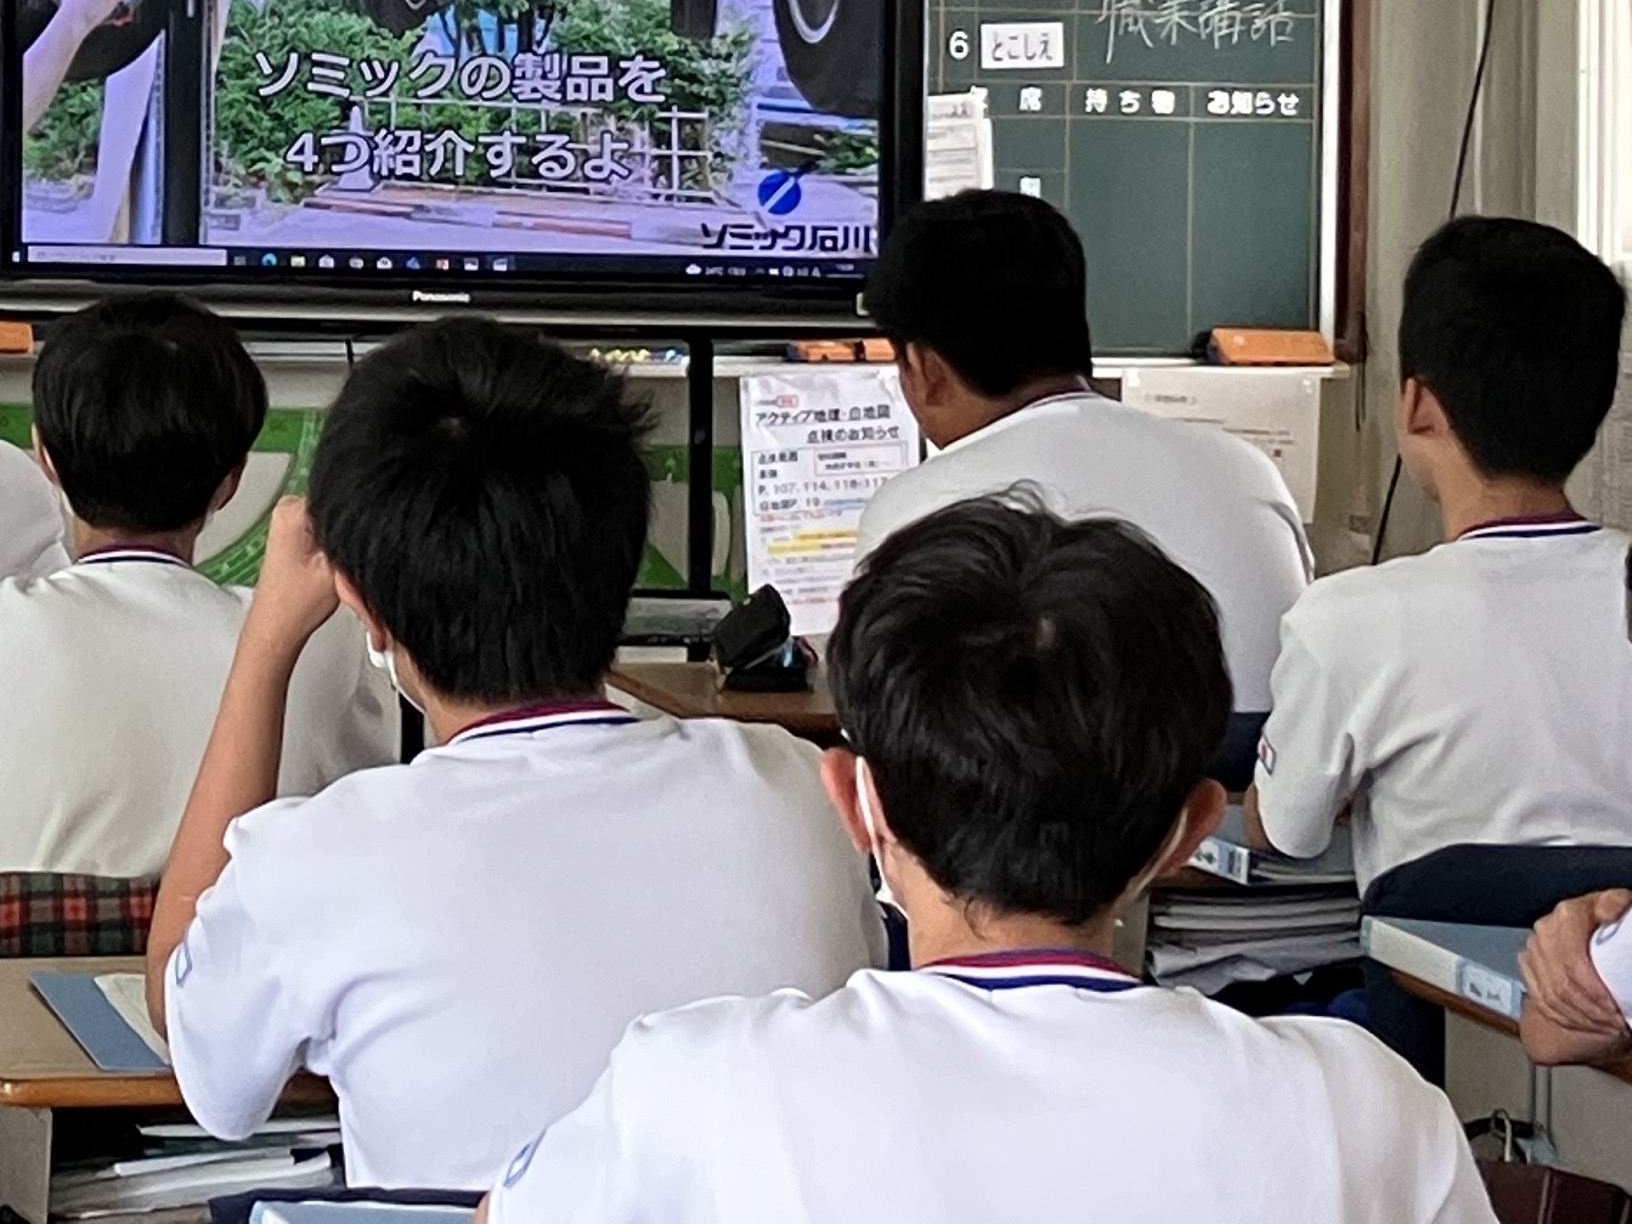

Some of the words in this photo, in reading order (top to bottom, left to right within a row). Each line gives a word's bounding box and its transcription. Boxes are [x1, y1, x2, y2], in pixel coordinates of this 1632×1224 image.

[949, 30, 970, 61] 6
[992, 32, 1054, 62] とこしえ
[255, 52, 667, 103] ソミックの製品を
[1206, 89, 1300, 116] お知らせ
[284, 128, 633, 178] 4つ紹介するよ
[700, 222, 872, 253] ソミック石川
[411, 290, 471, 304] Panasonic
